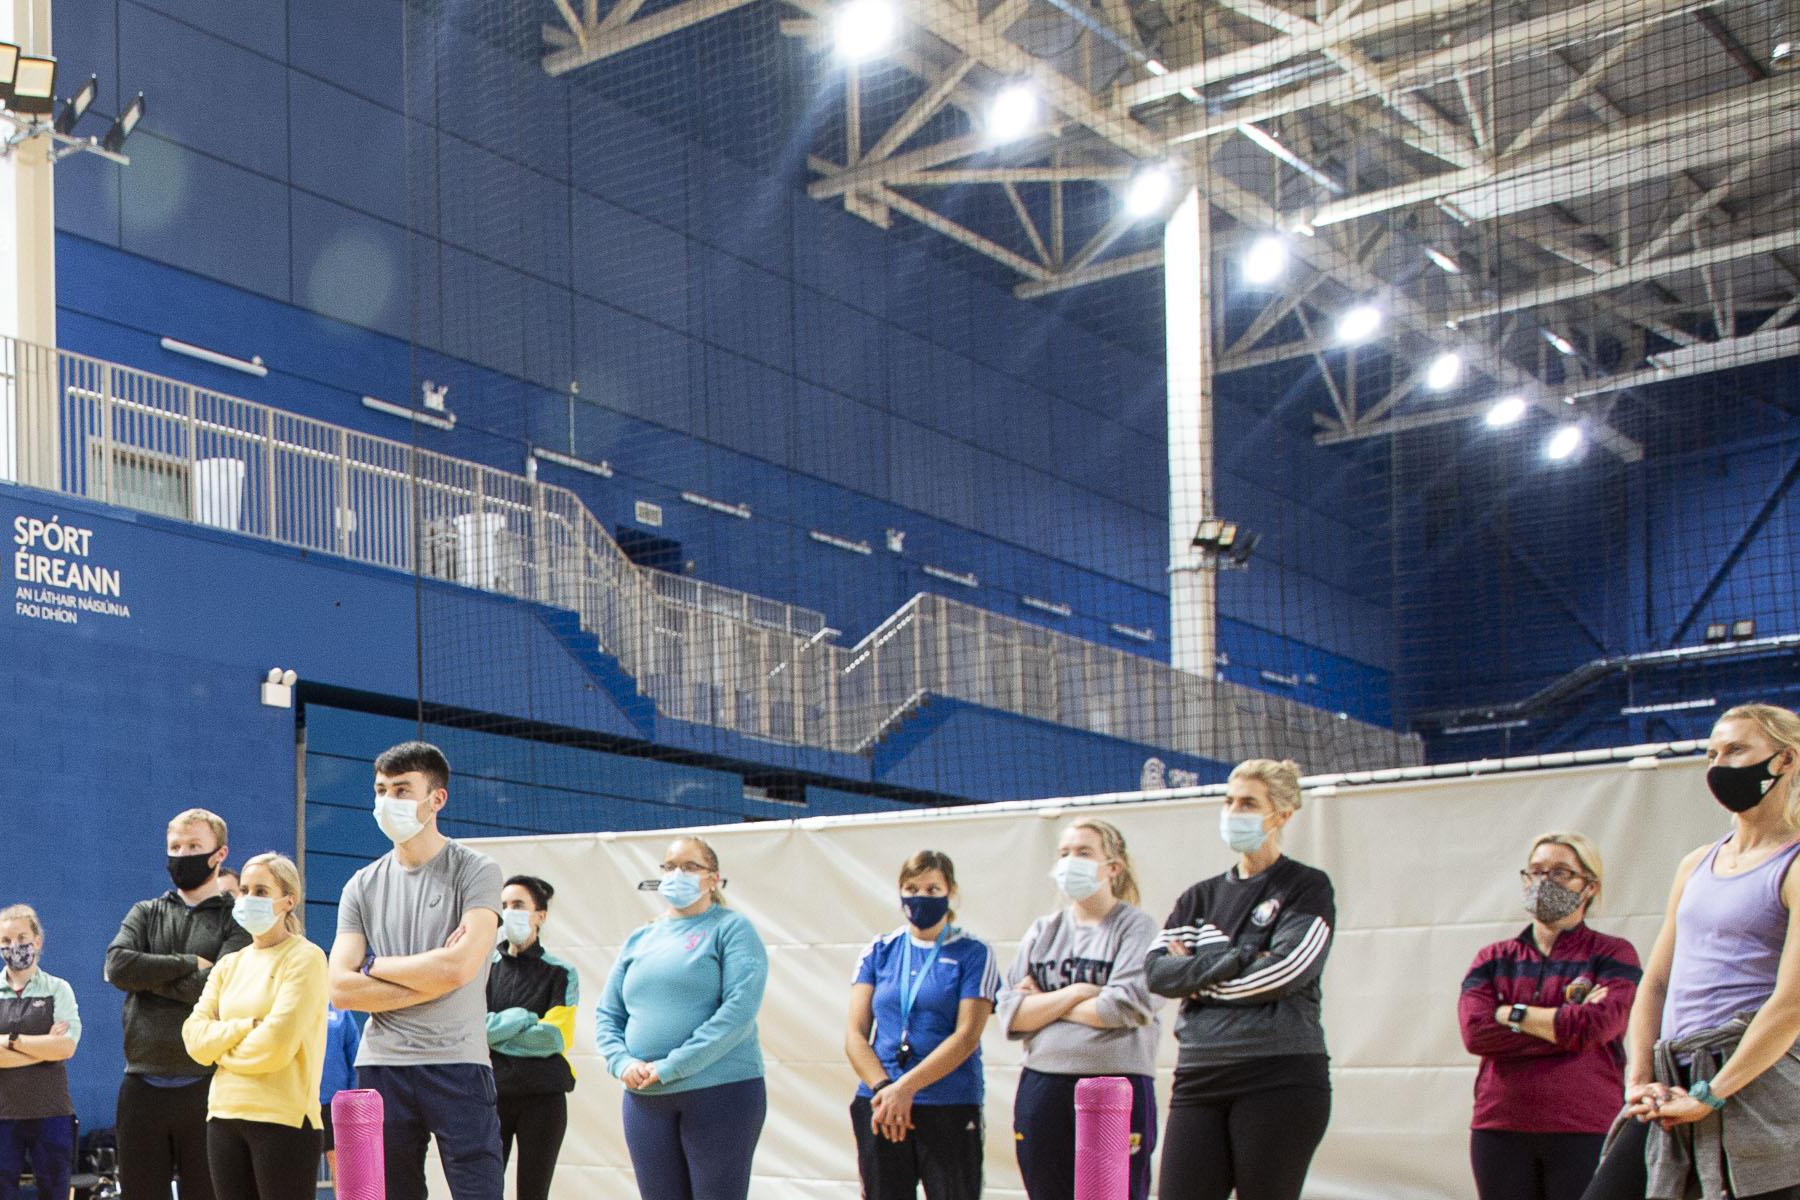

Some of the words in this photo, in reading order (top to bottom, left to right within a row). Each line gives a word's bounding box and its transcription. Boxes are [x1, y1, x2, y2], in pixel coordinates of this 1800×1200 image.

[13, 515, 93, 556] SPÓRT
[15, 545, 120, 597] ÉIREANN
[16, 586, 32, 600] AN
[34, 588, 77, 608] LÁTHAIR
[16, 602, 40, 618] FAOI
[41, 606, 78, 624] DHÍON
